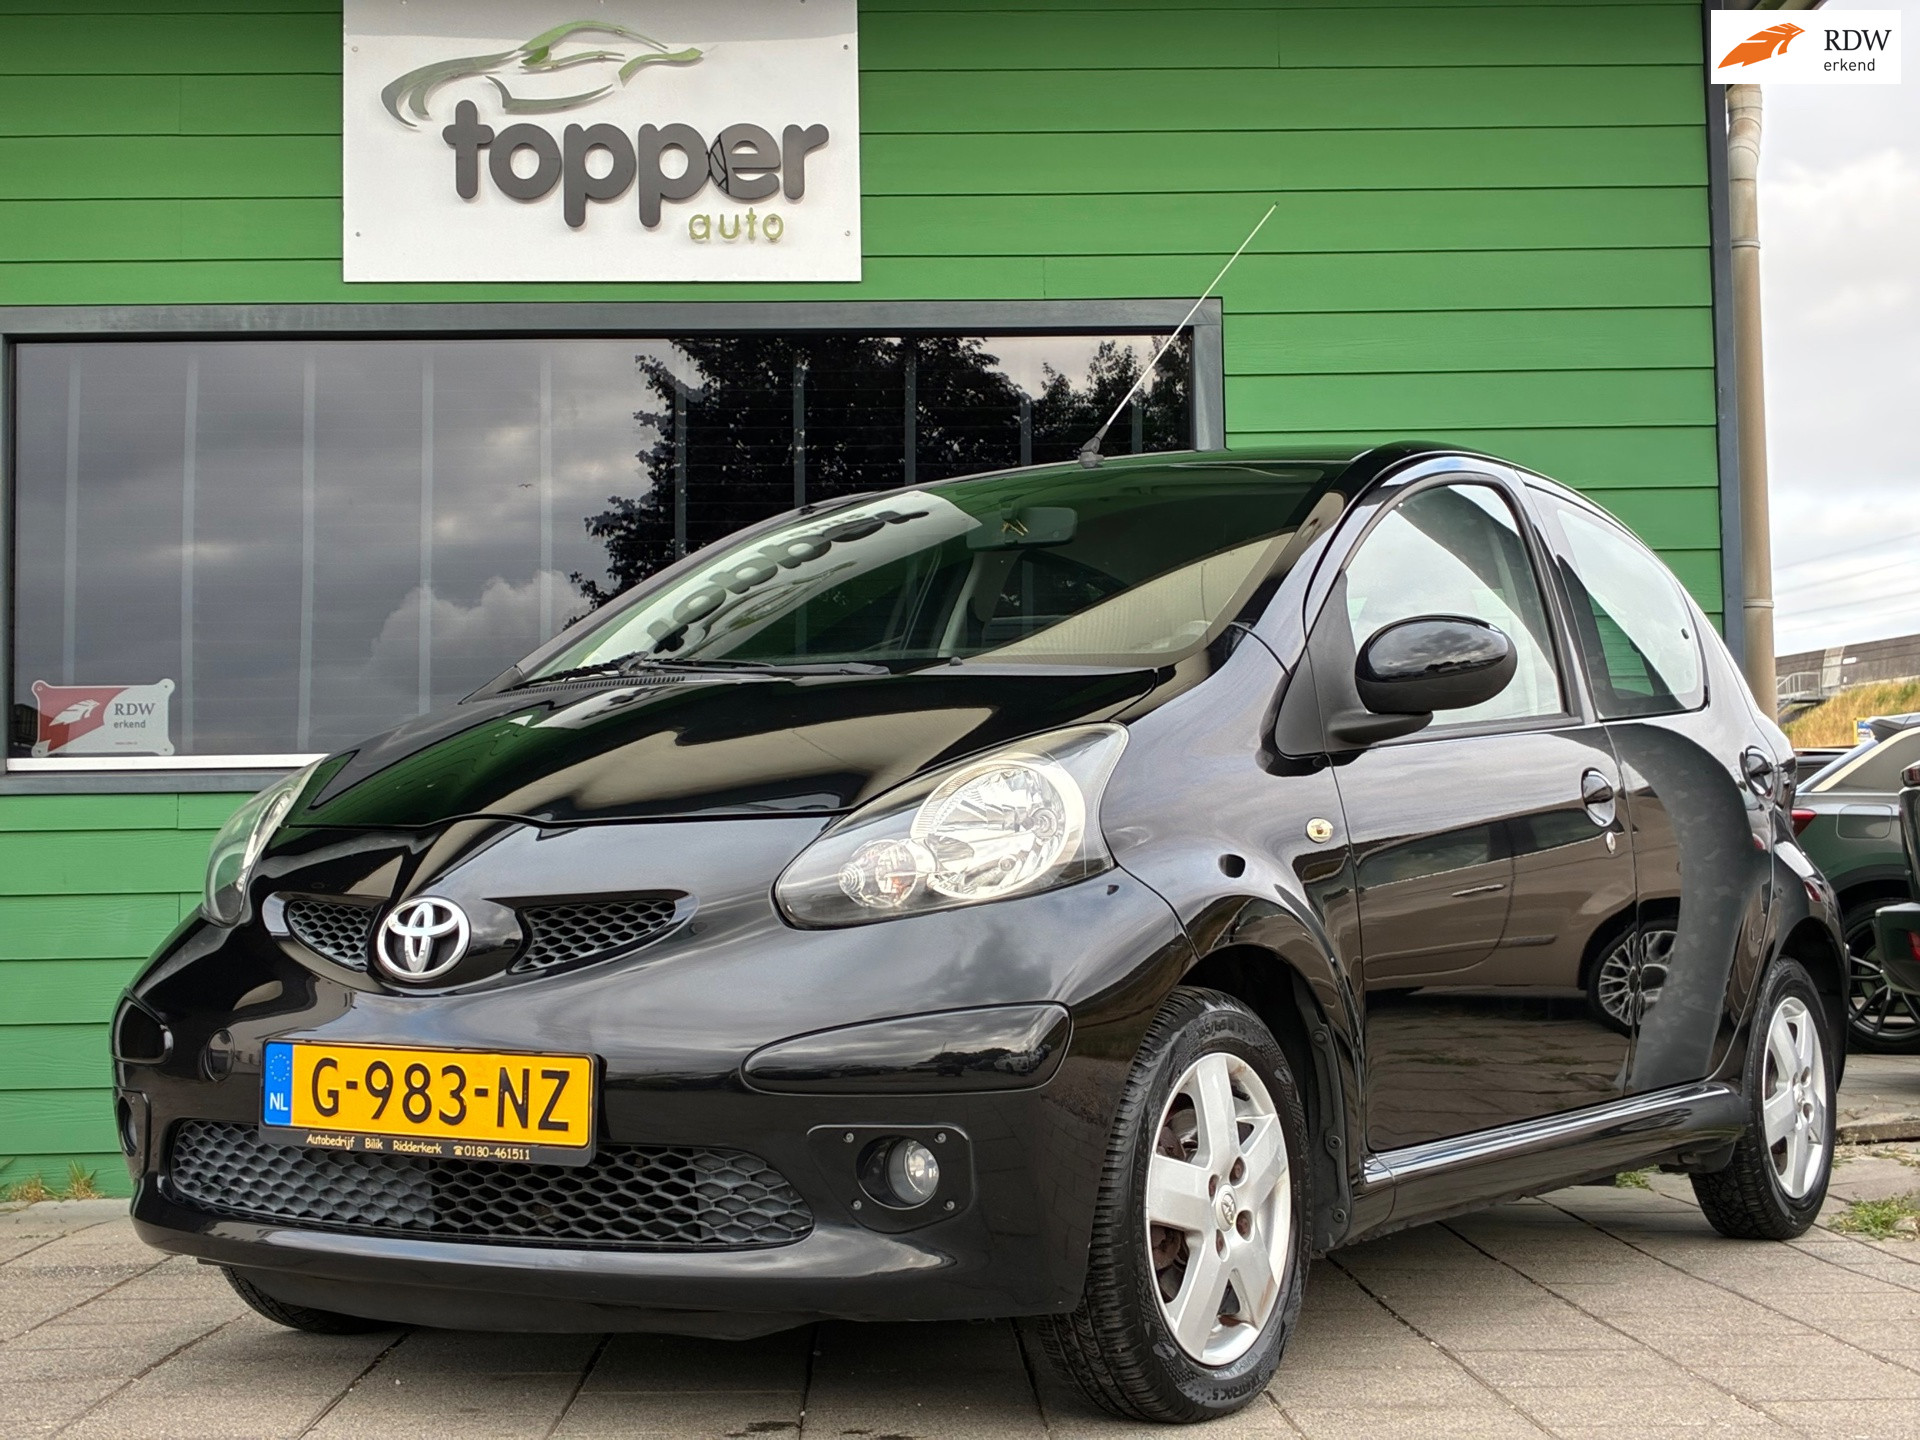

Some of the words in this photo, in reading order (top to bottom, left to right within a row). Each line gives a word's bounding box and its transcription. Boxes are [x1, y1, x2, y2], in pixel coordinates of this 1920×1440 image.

[442, 100, 830, 228] topper
[688, 208, 784, 242] auto
[113, 720, 146, 729] erkend
[114, 703, 156, 716] RDW
[269, 1092, 288, 1111] NL
[311, 1057, 571, 1132] G-983-NZ
[306, 1134, 355, 1150] Autobedrijf
[393, 1140, 442, 1154] Ridderkerk
[464, 1145, 530, 1160] 0180-461511
